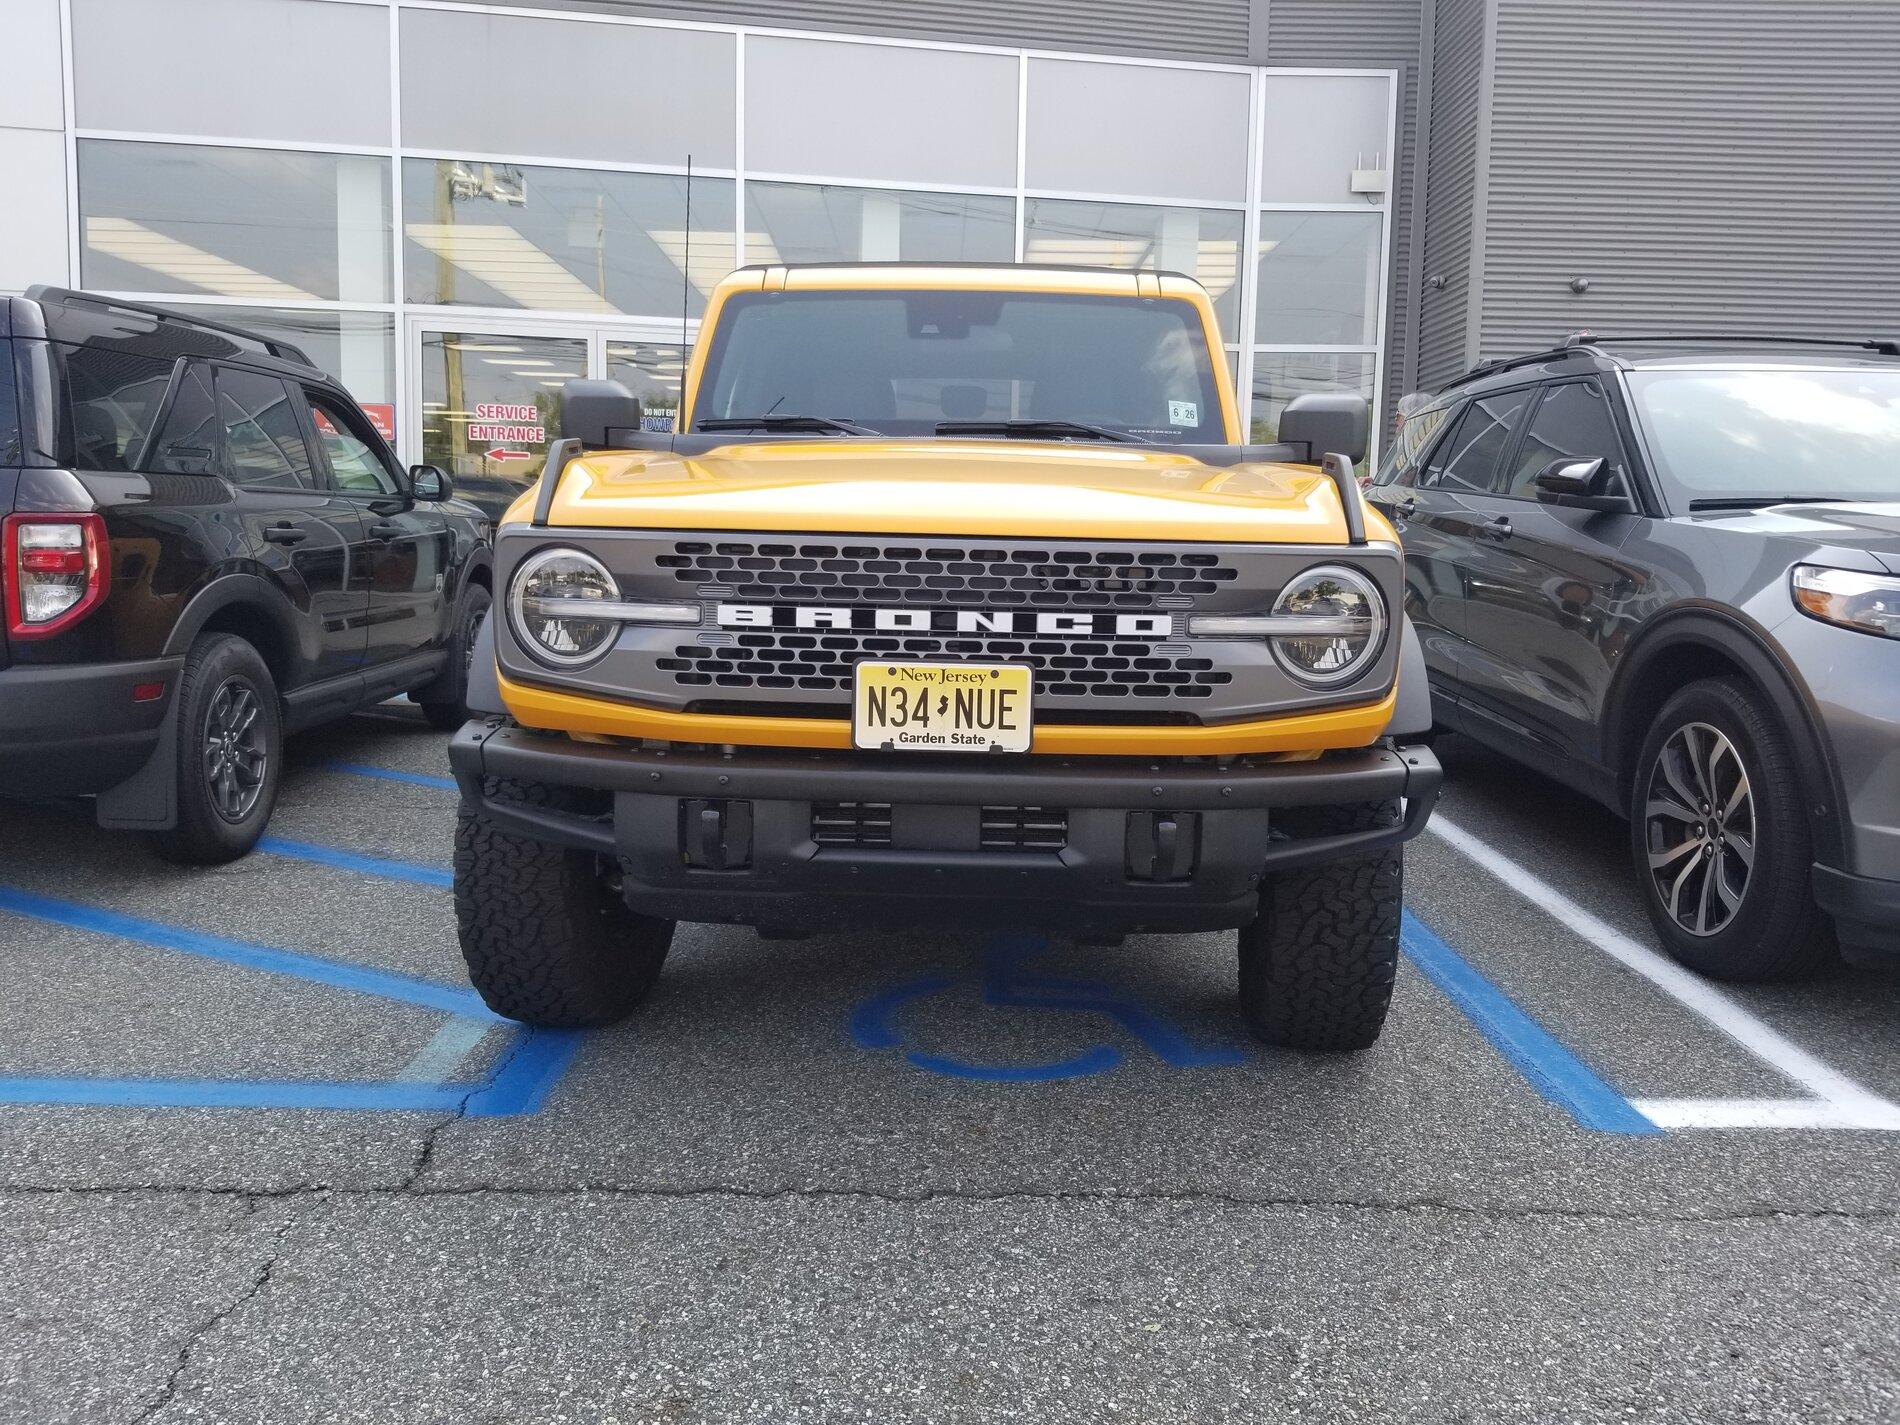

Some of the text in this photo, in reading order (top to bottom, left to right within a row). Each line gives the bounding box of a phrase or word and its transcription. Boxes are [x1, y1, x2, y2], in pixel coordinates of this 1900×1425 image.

[476, 404, 537, 421] SERVICE
[644, 408, 677, 417] DO NOT ENT
[1173, 408, 1195, 420] 6 26
[469, 424, 545, 443] ENTRANCE
[717, 604, 1173, 637] BRONCO
[900, 668, 987, 686] New Jersey
[868, 686, 1018, 731] N34 NUE
[899, 732, 986, 745] Garden State
